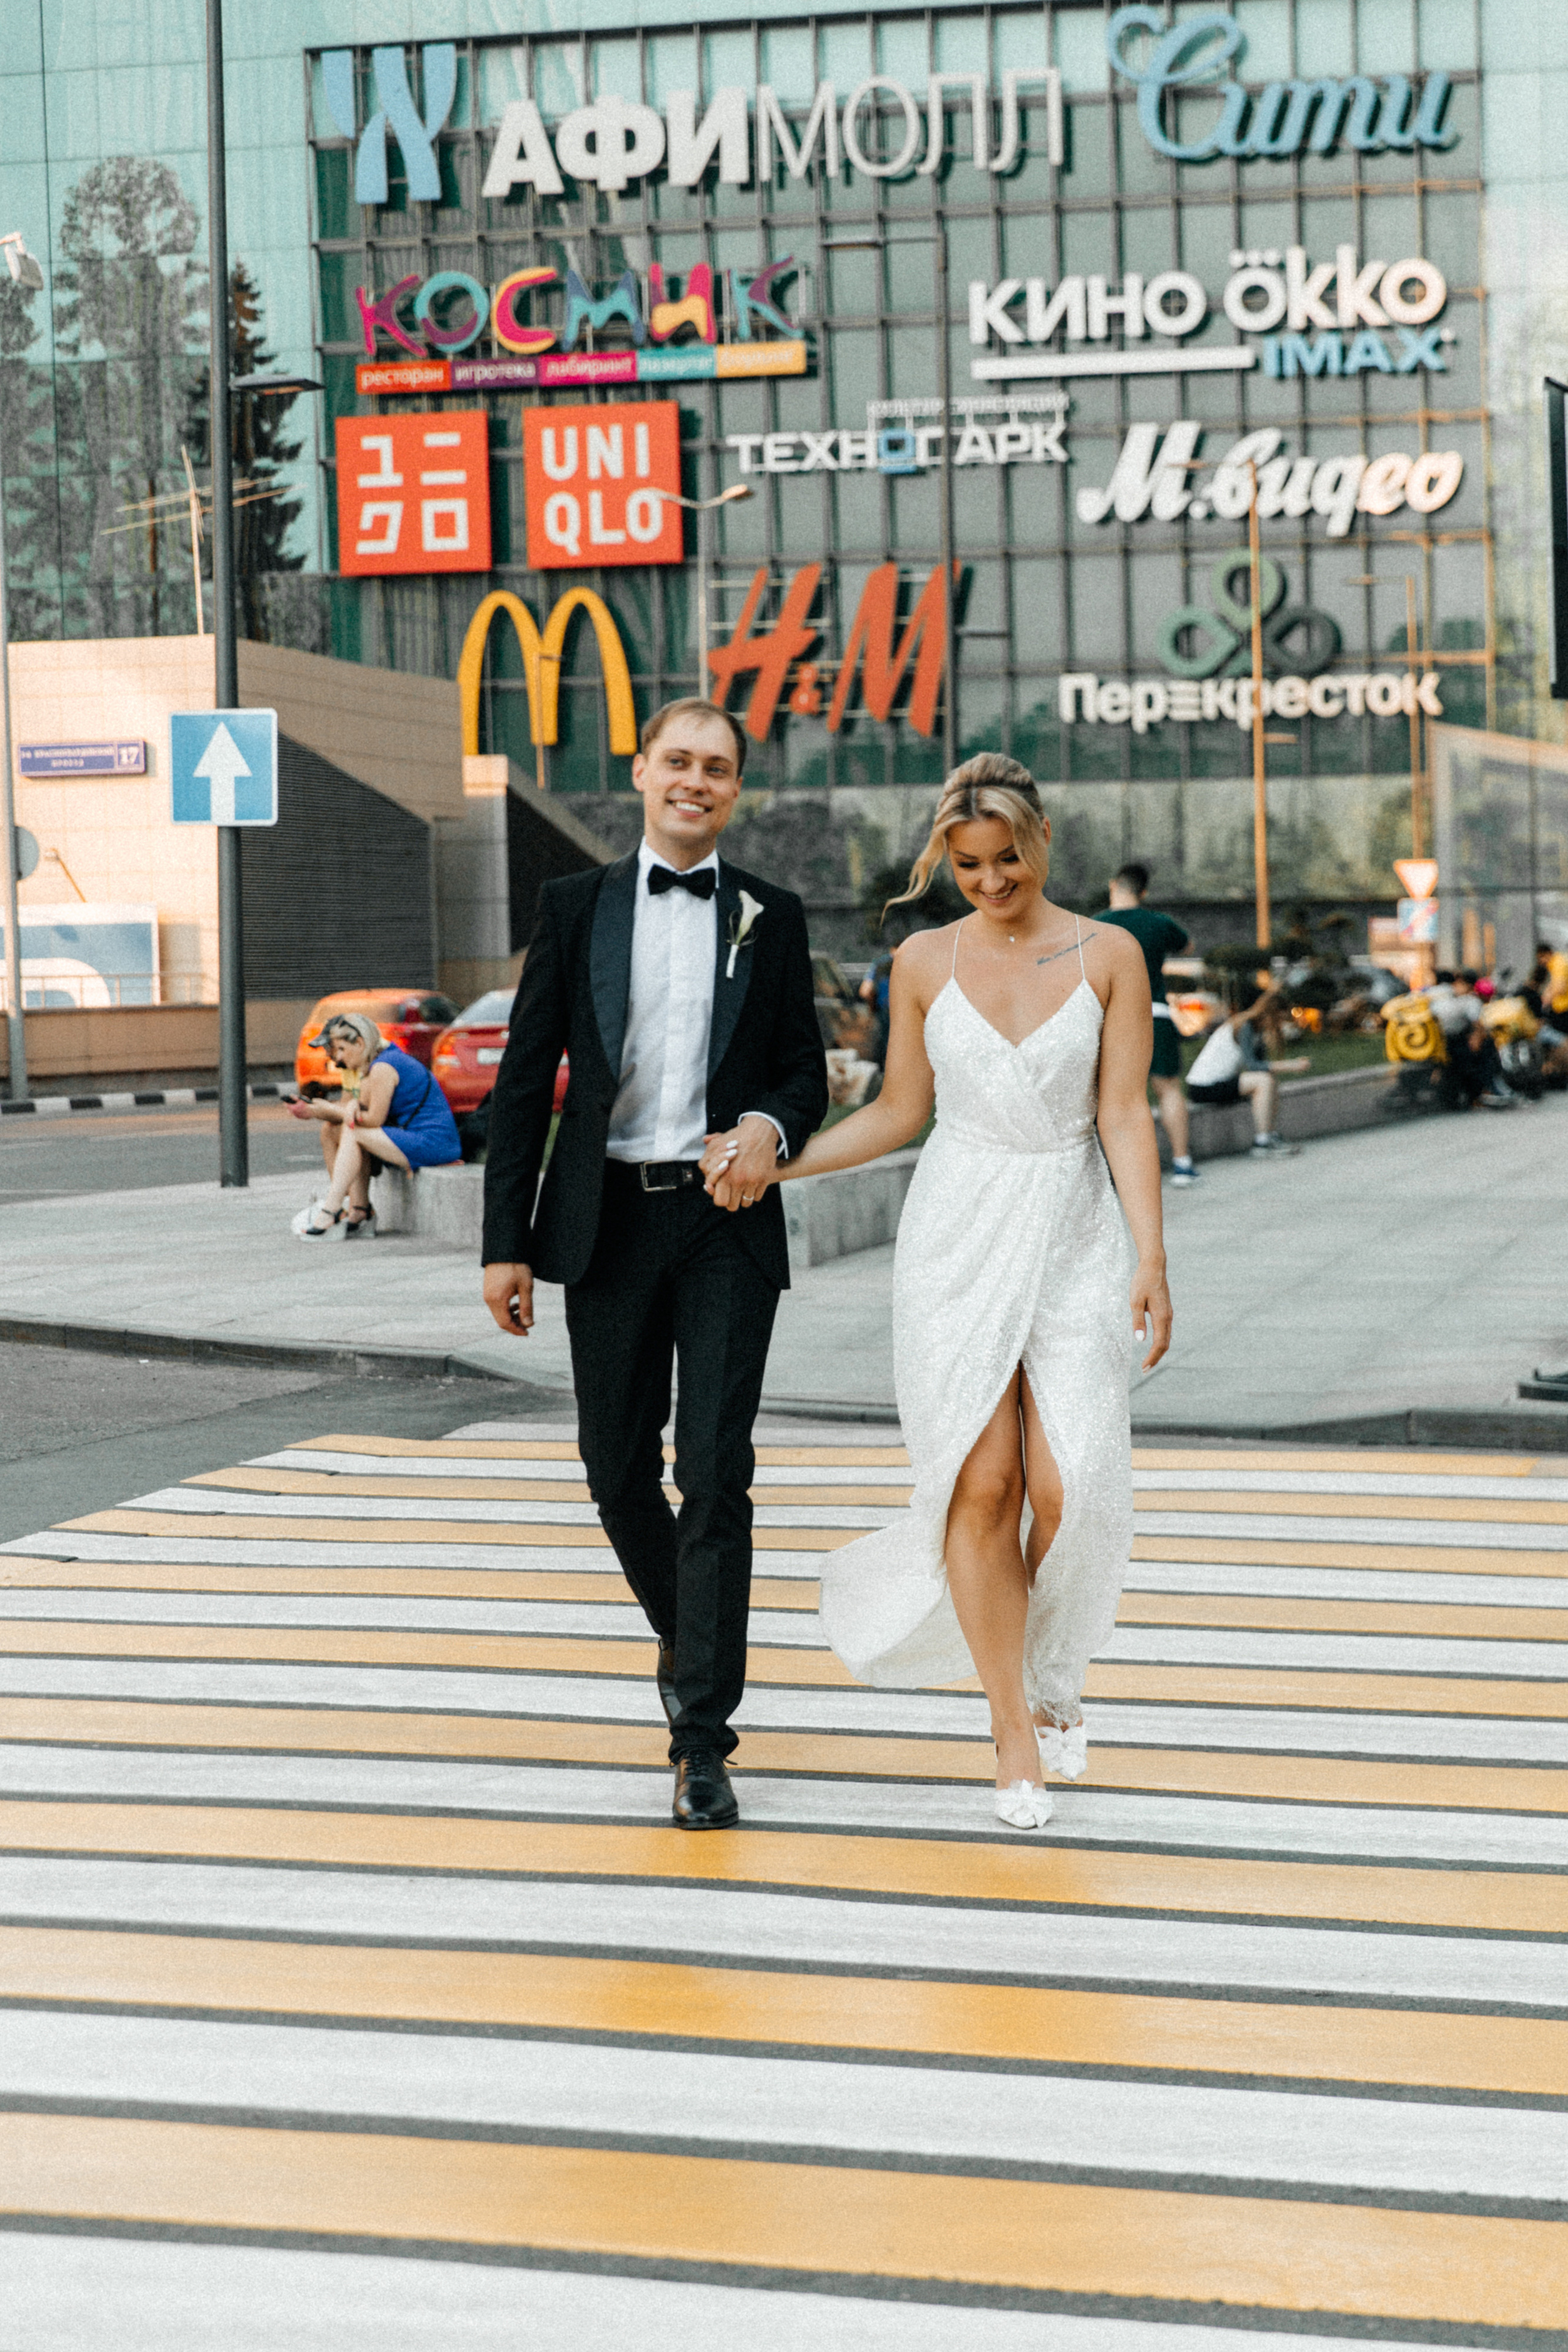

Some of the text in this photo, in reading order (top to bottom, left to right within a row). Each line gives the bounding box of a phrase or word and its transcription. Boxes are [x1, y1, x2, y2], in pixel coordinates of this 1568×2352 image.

[482, 6, 1457, 197] АФИМОЛЛ Сити
[356, 256, 804, 357] КОСМИК
[969, 271, 1207, 344] КИНО
[361, 366, 444, 388] ресторан
[455, 360, 535, 383] игротека
[1265, 331, 1447, 377] IMAX
[357, 432, 466, 488] ユニ
[541, 423, 649, 481] UNI
[356, 498, 469, 554] クロ
[544, 488, 663, 556] QLO
[707, 559, 962, 742] H&M
